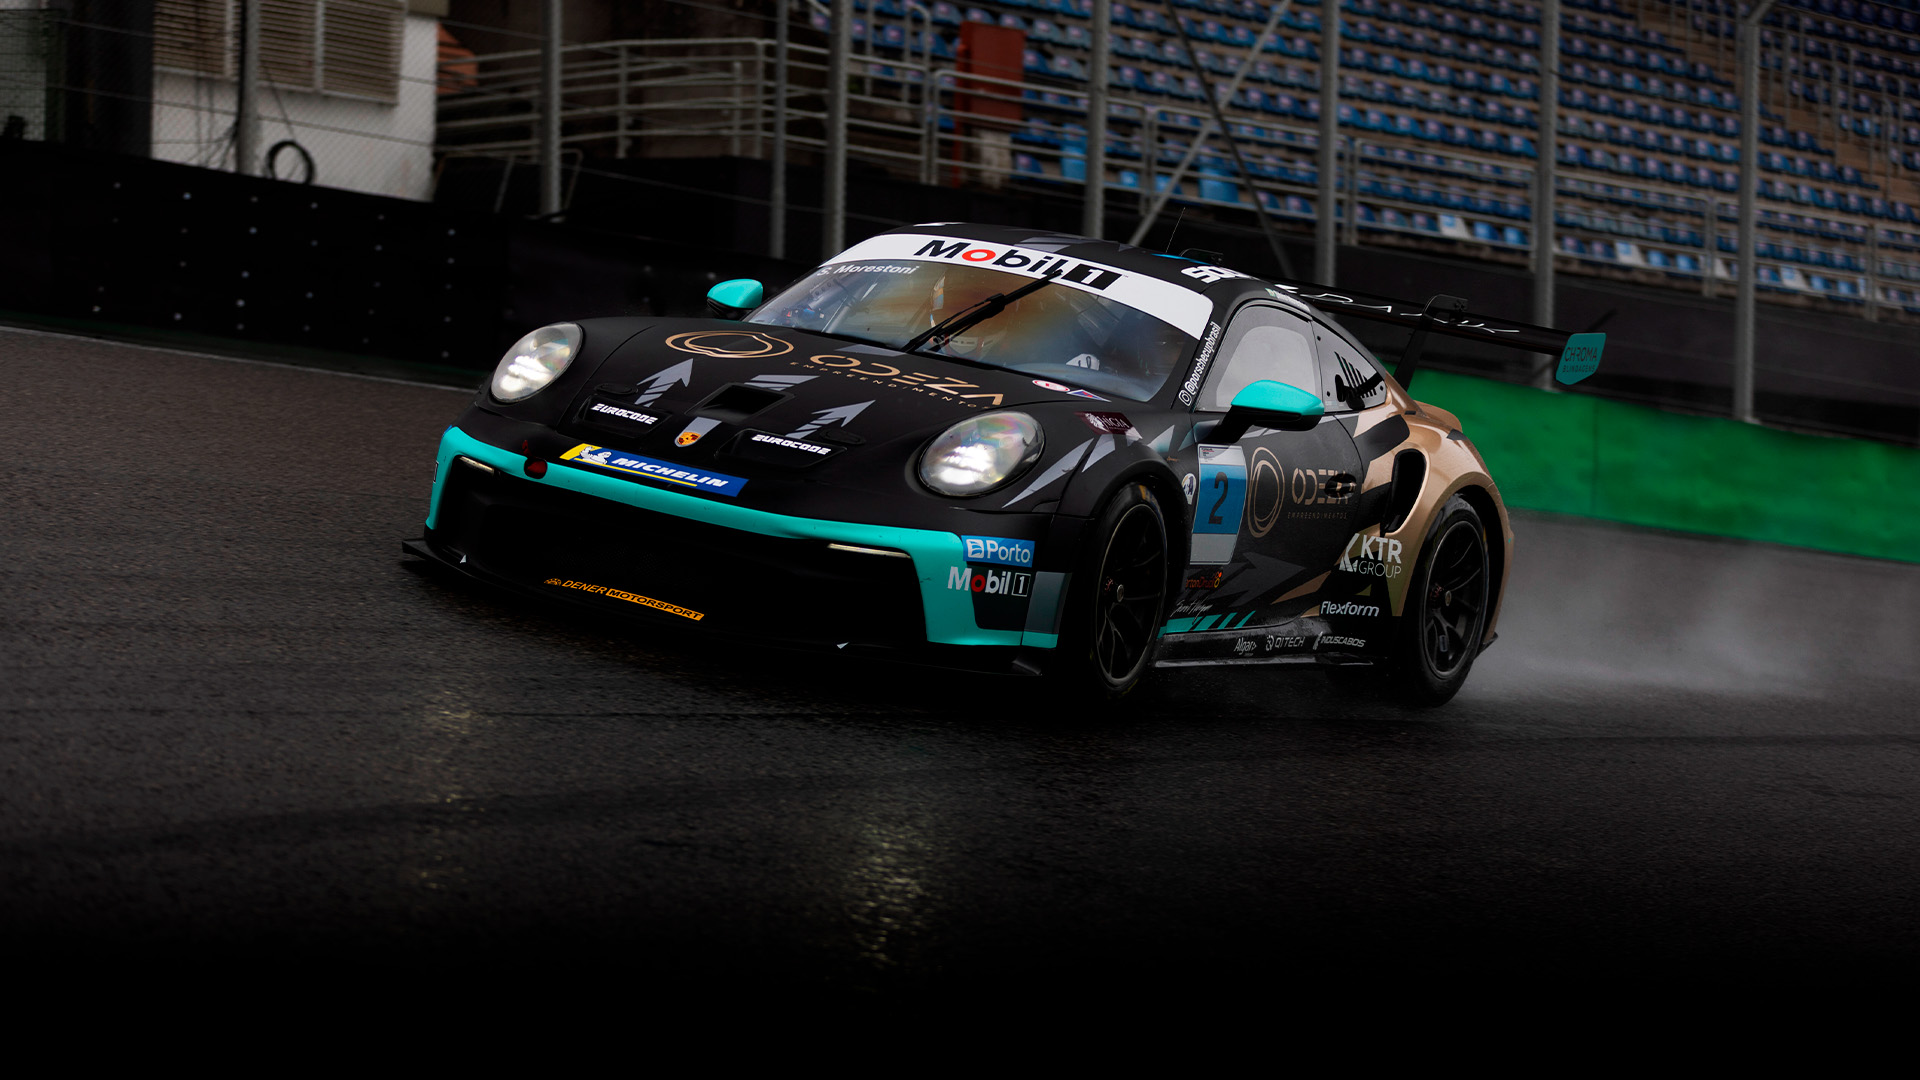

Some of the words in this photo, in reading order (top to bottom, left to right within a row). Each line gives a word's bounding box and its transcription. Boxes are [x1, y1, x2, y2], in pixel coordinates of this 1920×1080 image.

[817, 264, 830, 276] S.
[831, 263, 921, 276] Morestoni
[913, 240, 1068, 277] Mobil
[1183, 321, 1222, 396] @porschecupbrasil
[590, 403, 659, 425] EUROCODE
[750, 434, 832, 456] EUROCODE
[611, 457, 729, 488] MICHELIN
[1208, 471, 1229, 525] 2
[985, 539, 1031, 564] Porto
[1360, 533, 1403, 564] KTR
[947, 565, 1012, 596] Mobil
[1358, 560, 1402, 579] GROUP
[561, 579, 608, 595] DENER
[609, 589, 701, 619] MOTORSPORT
[1320, 600, 1380, 617] Flexform
